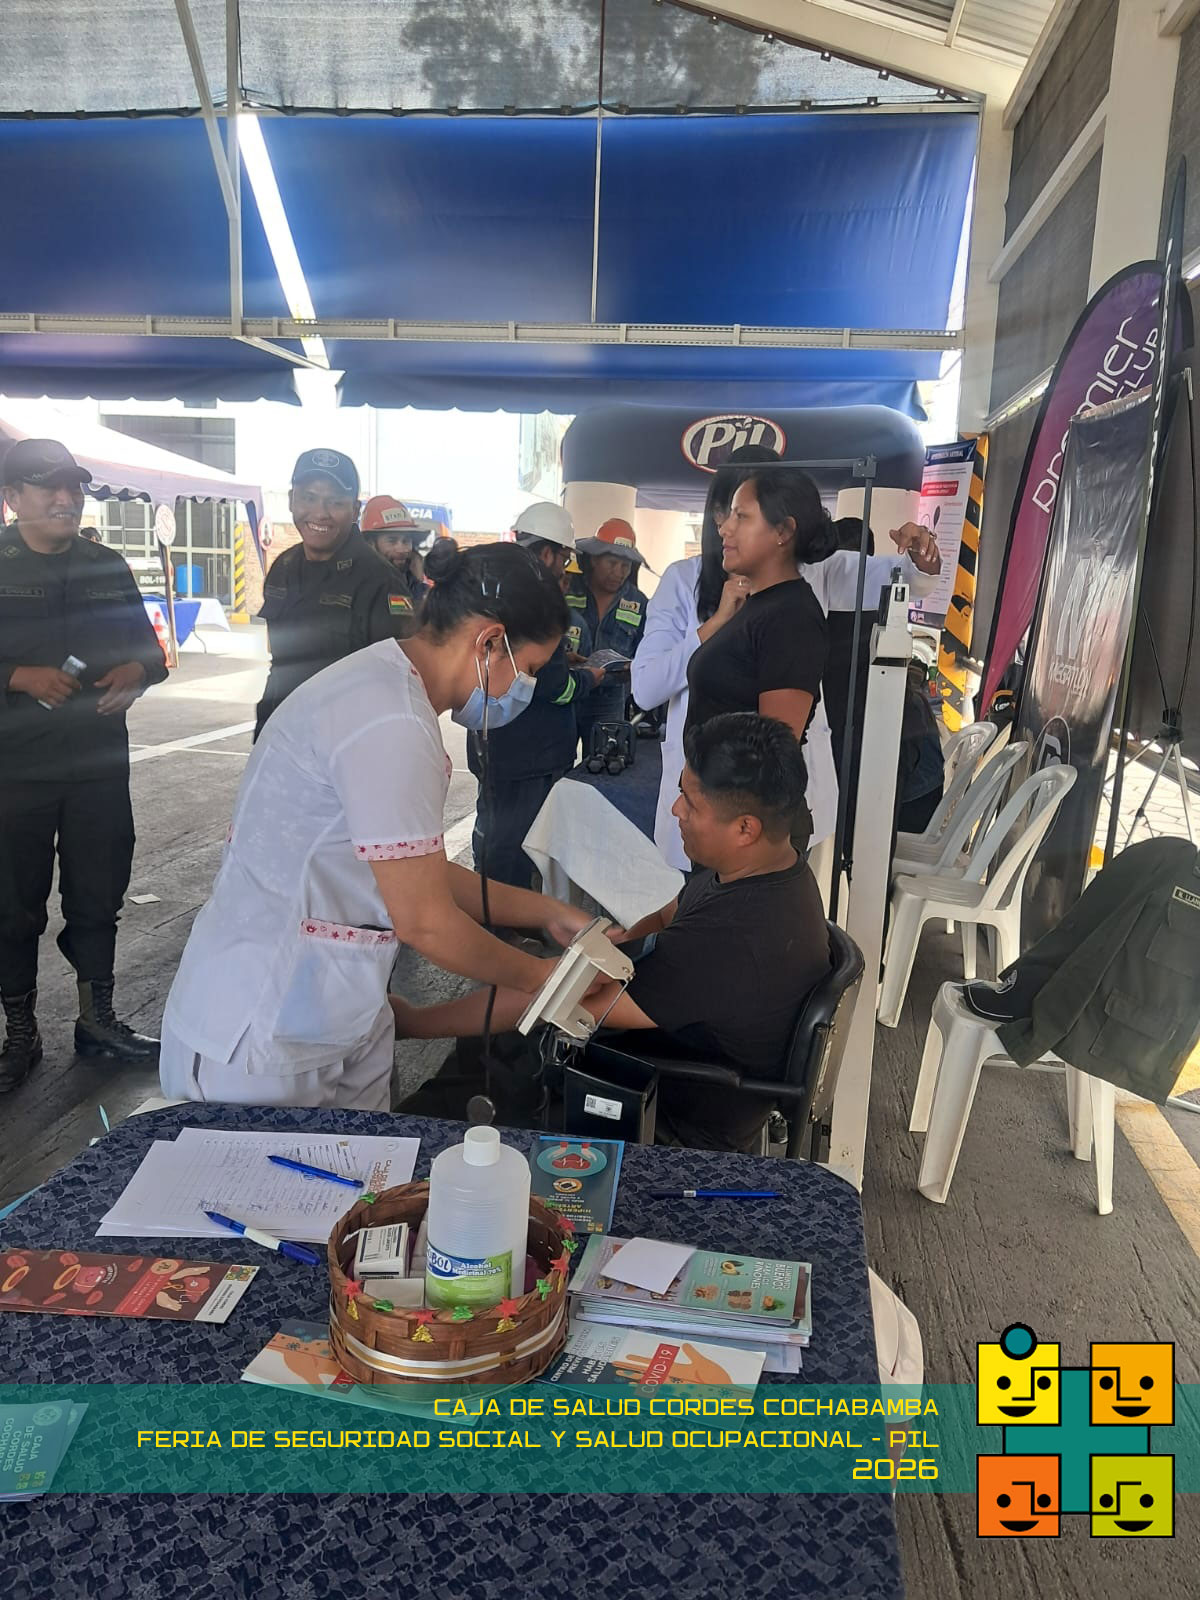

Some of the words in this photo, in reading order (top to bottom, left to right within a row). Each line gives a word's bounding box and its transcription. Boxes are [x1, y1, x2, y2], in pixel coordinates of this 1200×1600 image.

[452, 1266, 486, 1276] Medicinal
[641, 1349, 673, 1394] COVID-19
[24, 1425, 34, 1439] DE
[2, 1430, 22, 1472] CORDES
[14, 1441, 31, 1473] SALUD
[29, 1435, 43, 1461] CAJA
